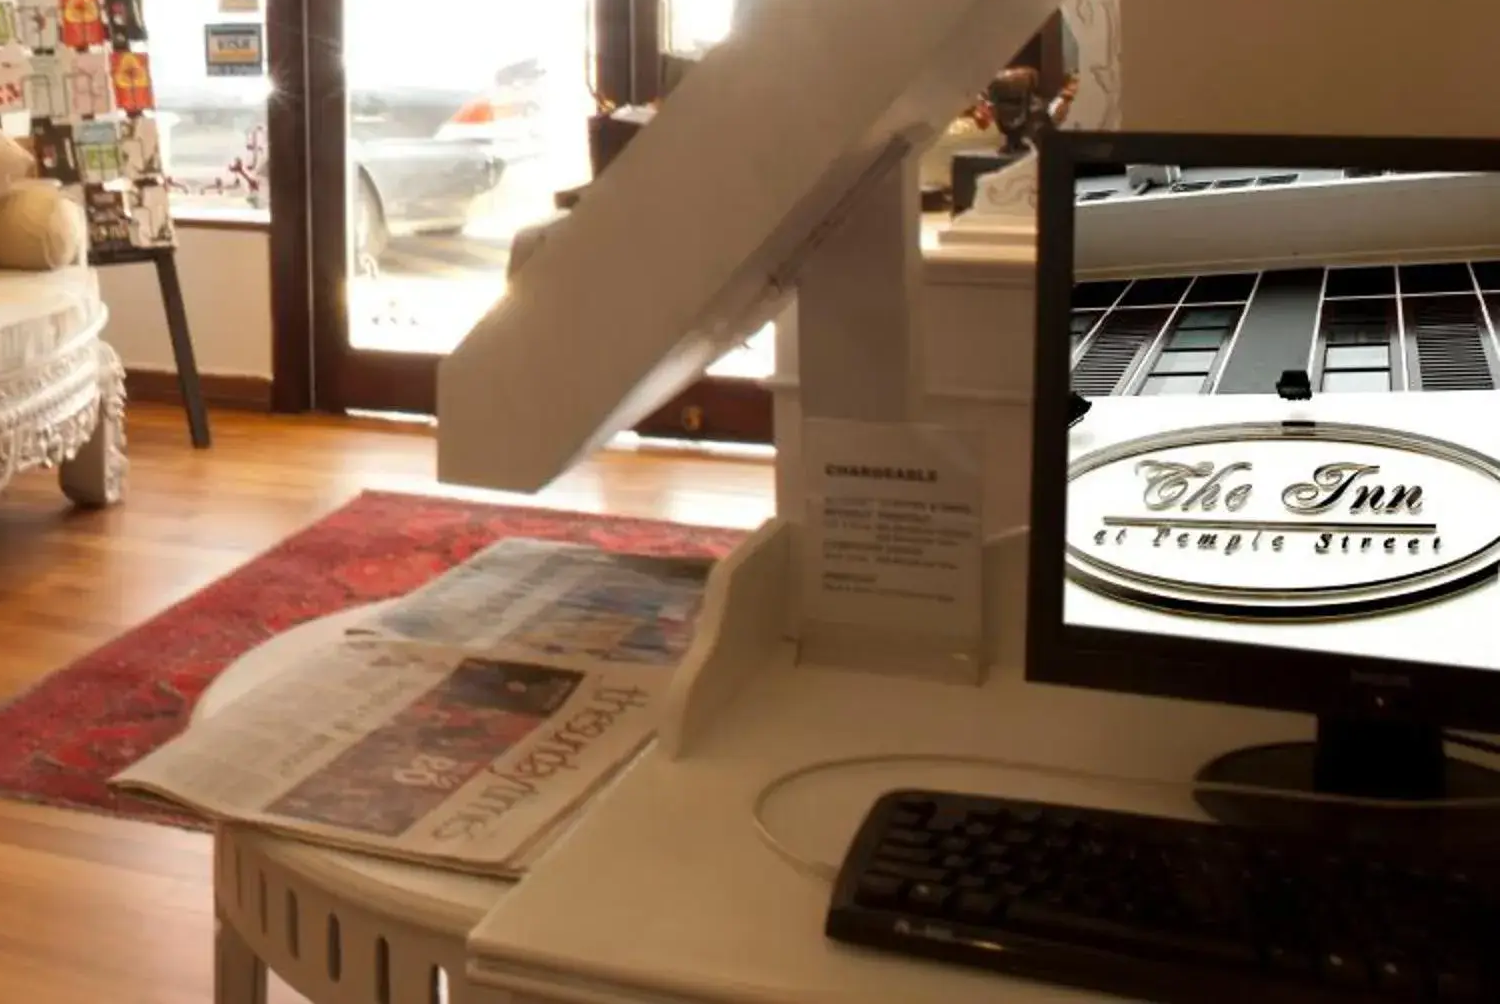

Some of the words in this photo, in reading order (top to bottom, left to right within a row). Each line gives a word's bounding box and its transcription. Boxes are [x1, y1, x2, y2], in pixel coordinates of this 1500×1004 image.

[1134, 459, 1254, 512] The
[1281, 461, 1425, 515] Inn
[1152, 526, 1285, 556] Temple
[1314, 533, 1441, 554] Street
